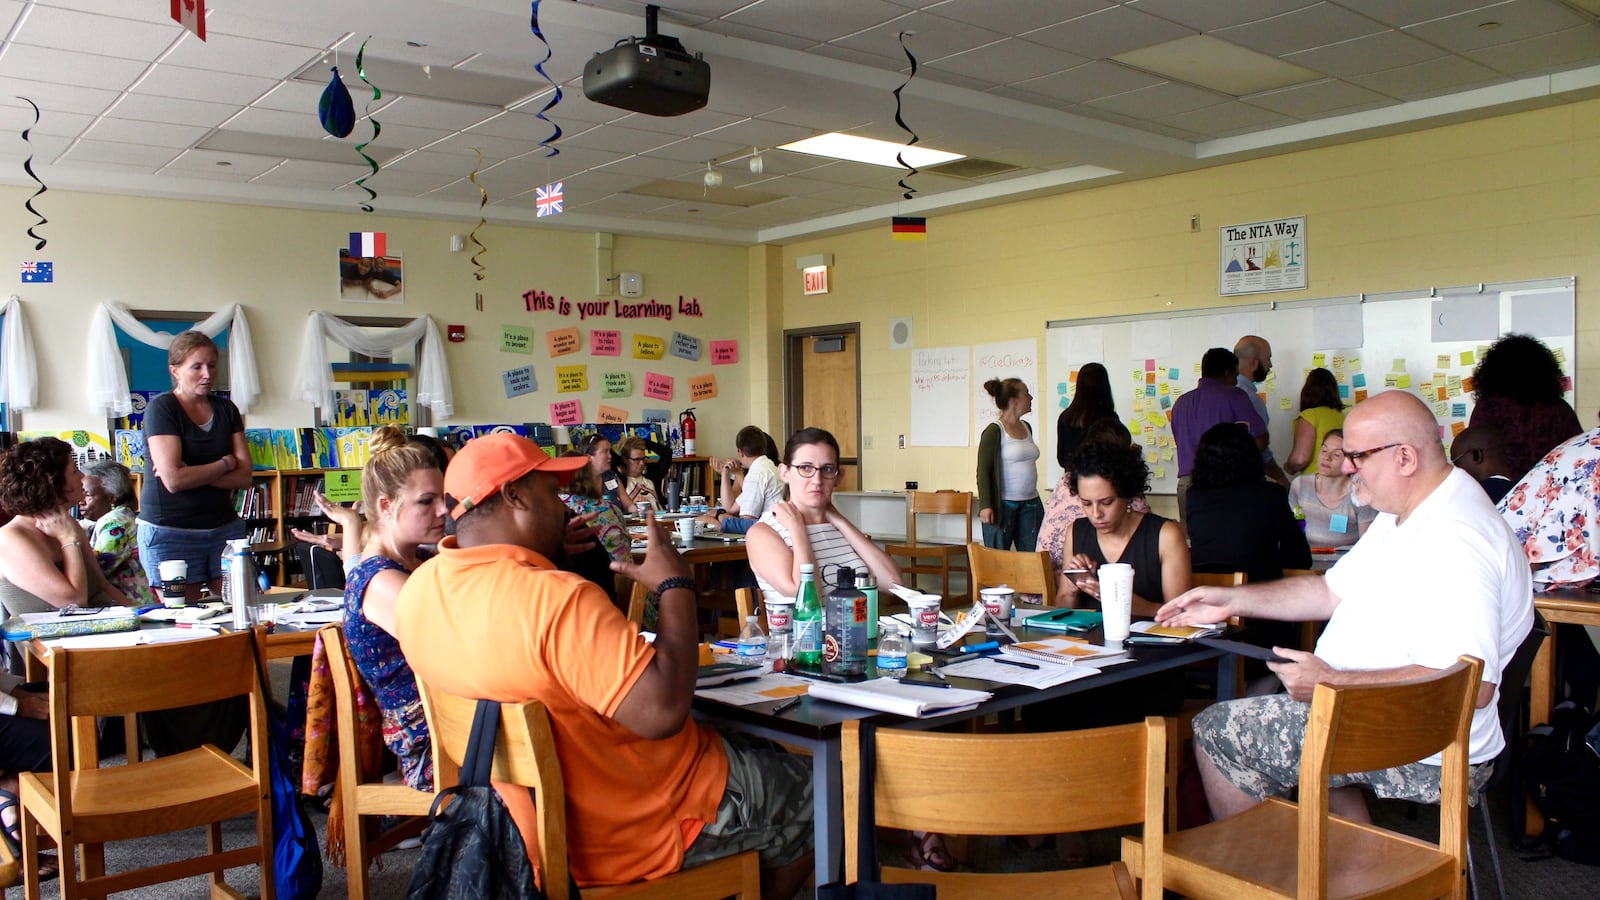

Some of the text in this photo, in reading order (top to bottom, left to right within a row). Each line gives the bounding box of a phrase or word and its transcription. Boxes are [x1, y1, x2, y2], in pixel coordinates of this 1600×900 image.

[1227, 222, 1299, 241] The NTA Way
[805, 271, 825, 292] EXIT
[522, 291, 703, 320] This is your Learning Lab.
[512, 369, 524, 377] place
[560, 402, 570, 411] place
[606, 413, 616, 421] place
